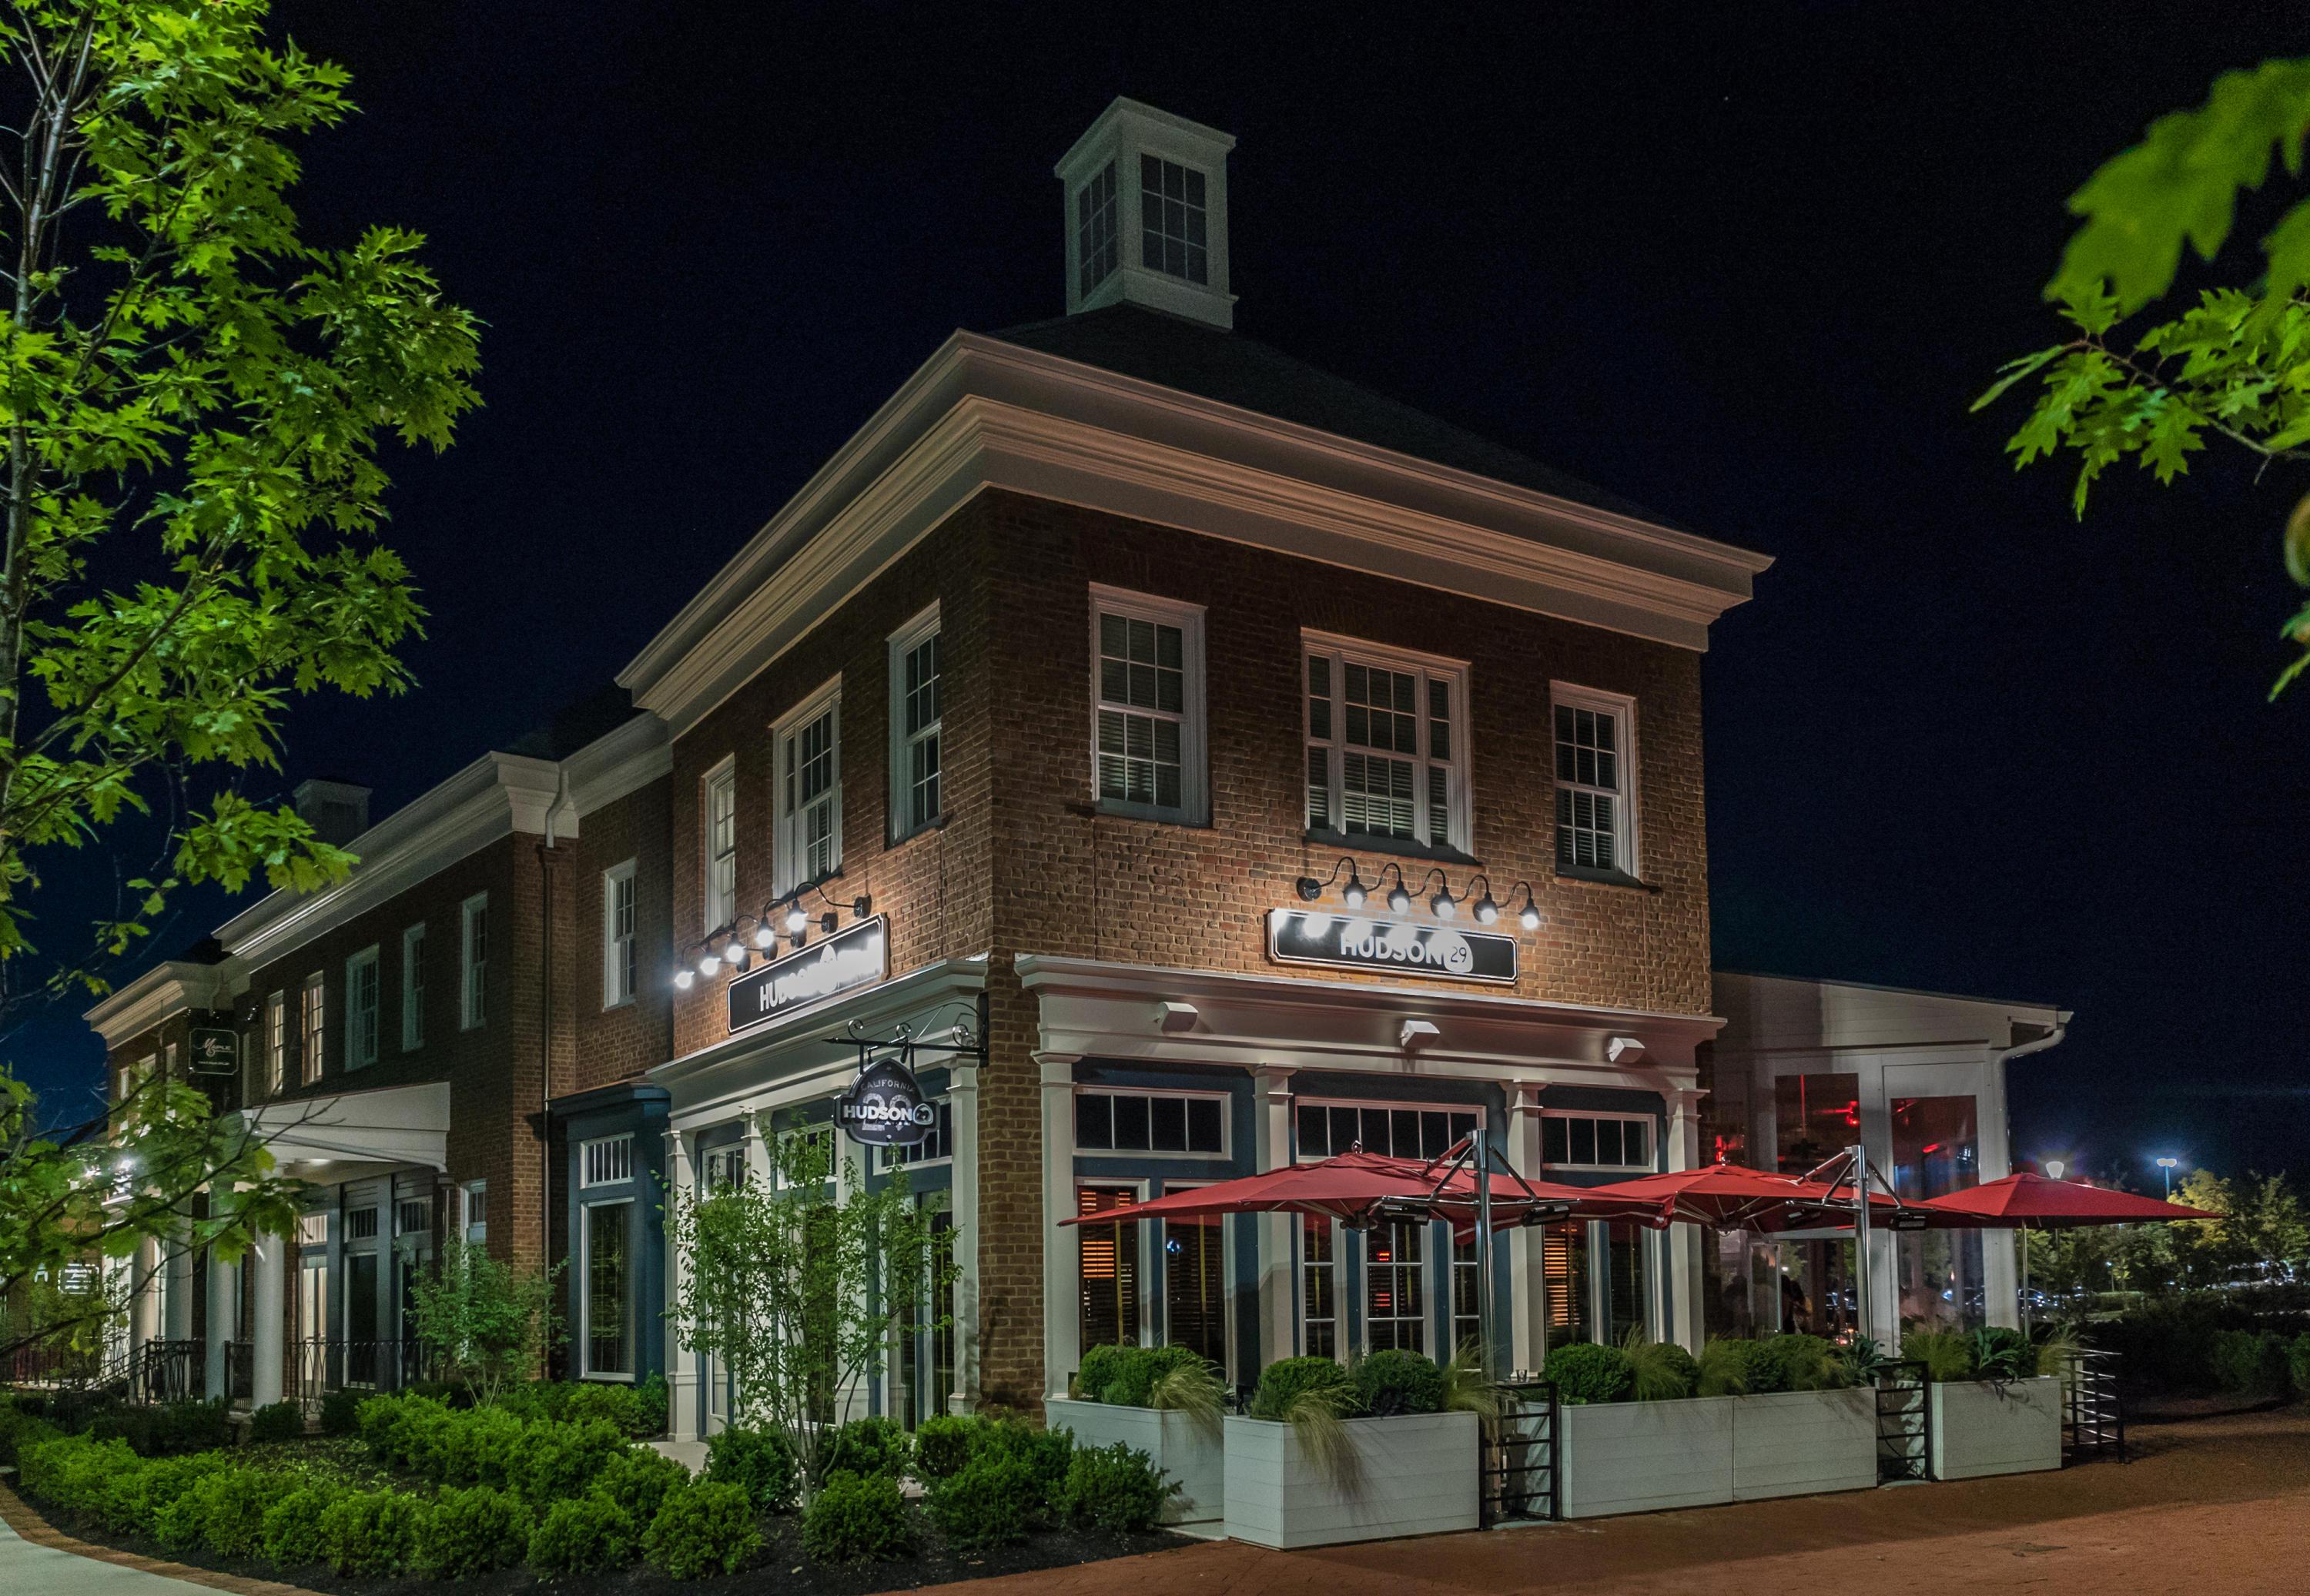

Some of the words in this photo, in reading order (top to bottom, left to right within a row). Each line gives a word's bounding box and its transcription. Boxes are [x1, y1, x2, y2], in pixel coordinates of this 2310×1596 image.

[1451, 946, 1467, 962] 29
[861, 1079, 916, 1092] CALIFORNIA
[843, 1105, 913, 1122] HUDSON
